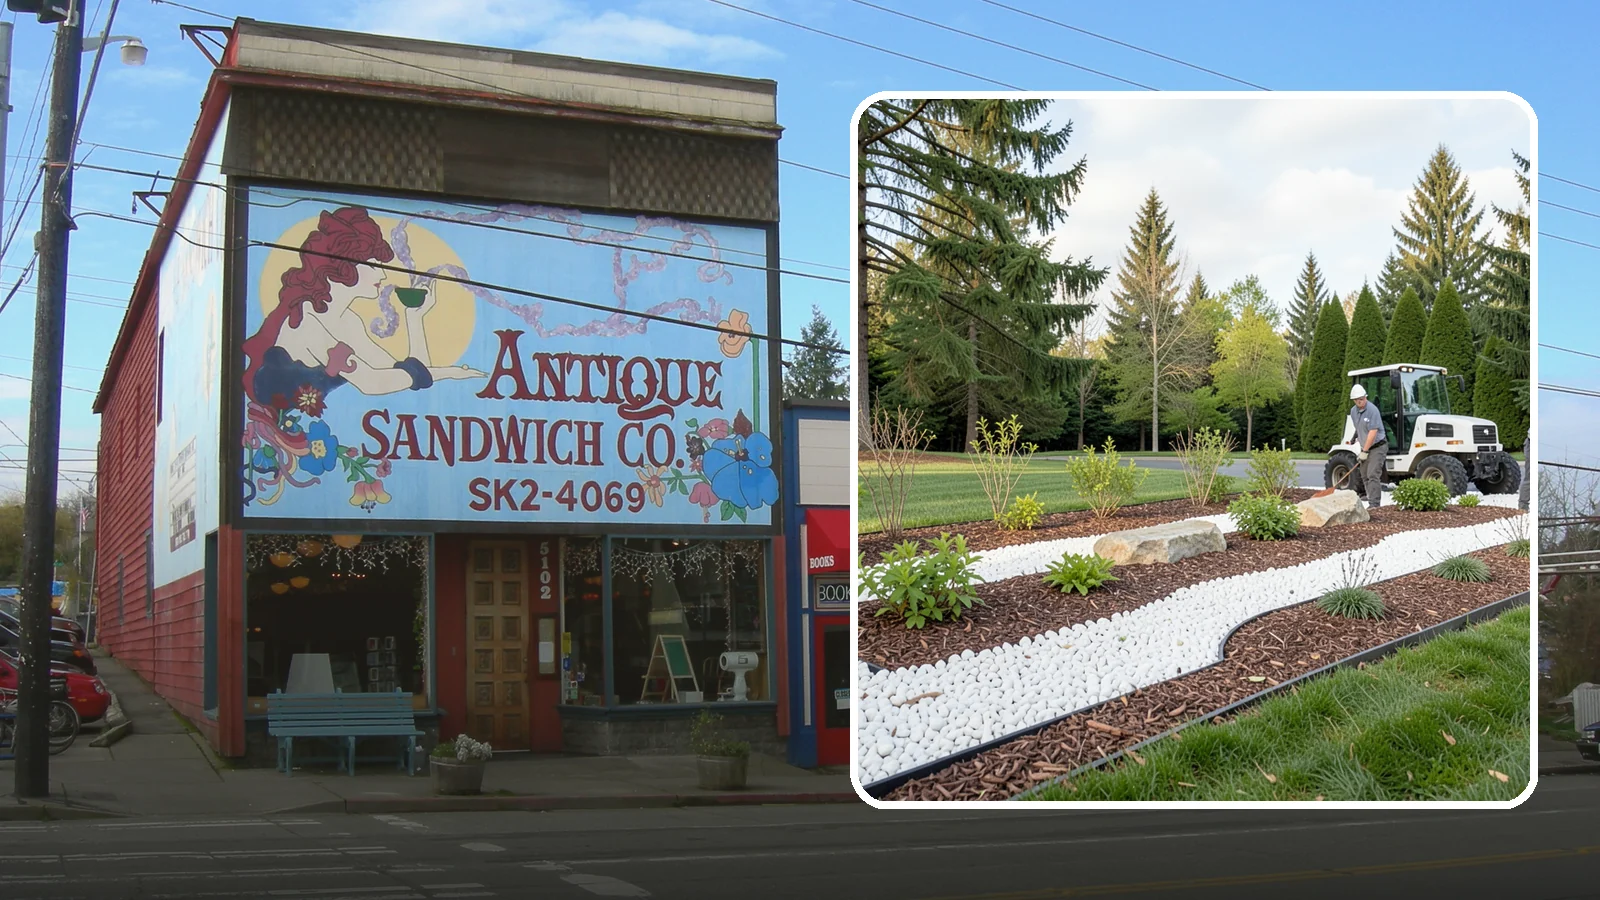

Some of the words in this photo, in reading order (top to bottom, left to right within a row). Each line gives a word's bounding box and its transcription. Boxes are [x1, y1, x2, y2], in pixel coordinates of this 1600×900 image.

[475, 329, 724, 421] ANTIQUE
[361, 408, 605, 467] SANDWICH
[616, 421, 685, 468] CO.
[467, 476, 646, 513] SK2-4069
[539, 541, 552, 600] 5102
[809, 554, 835, 569] BOOKS
